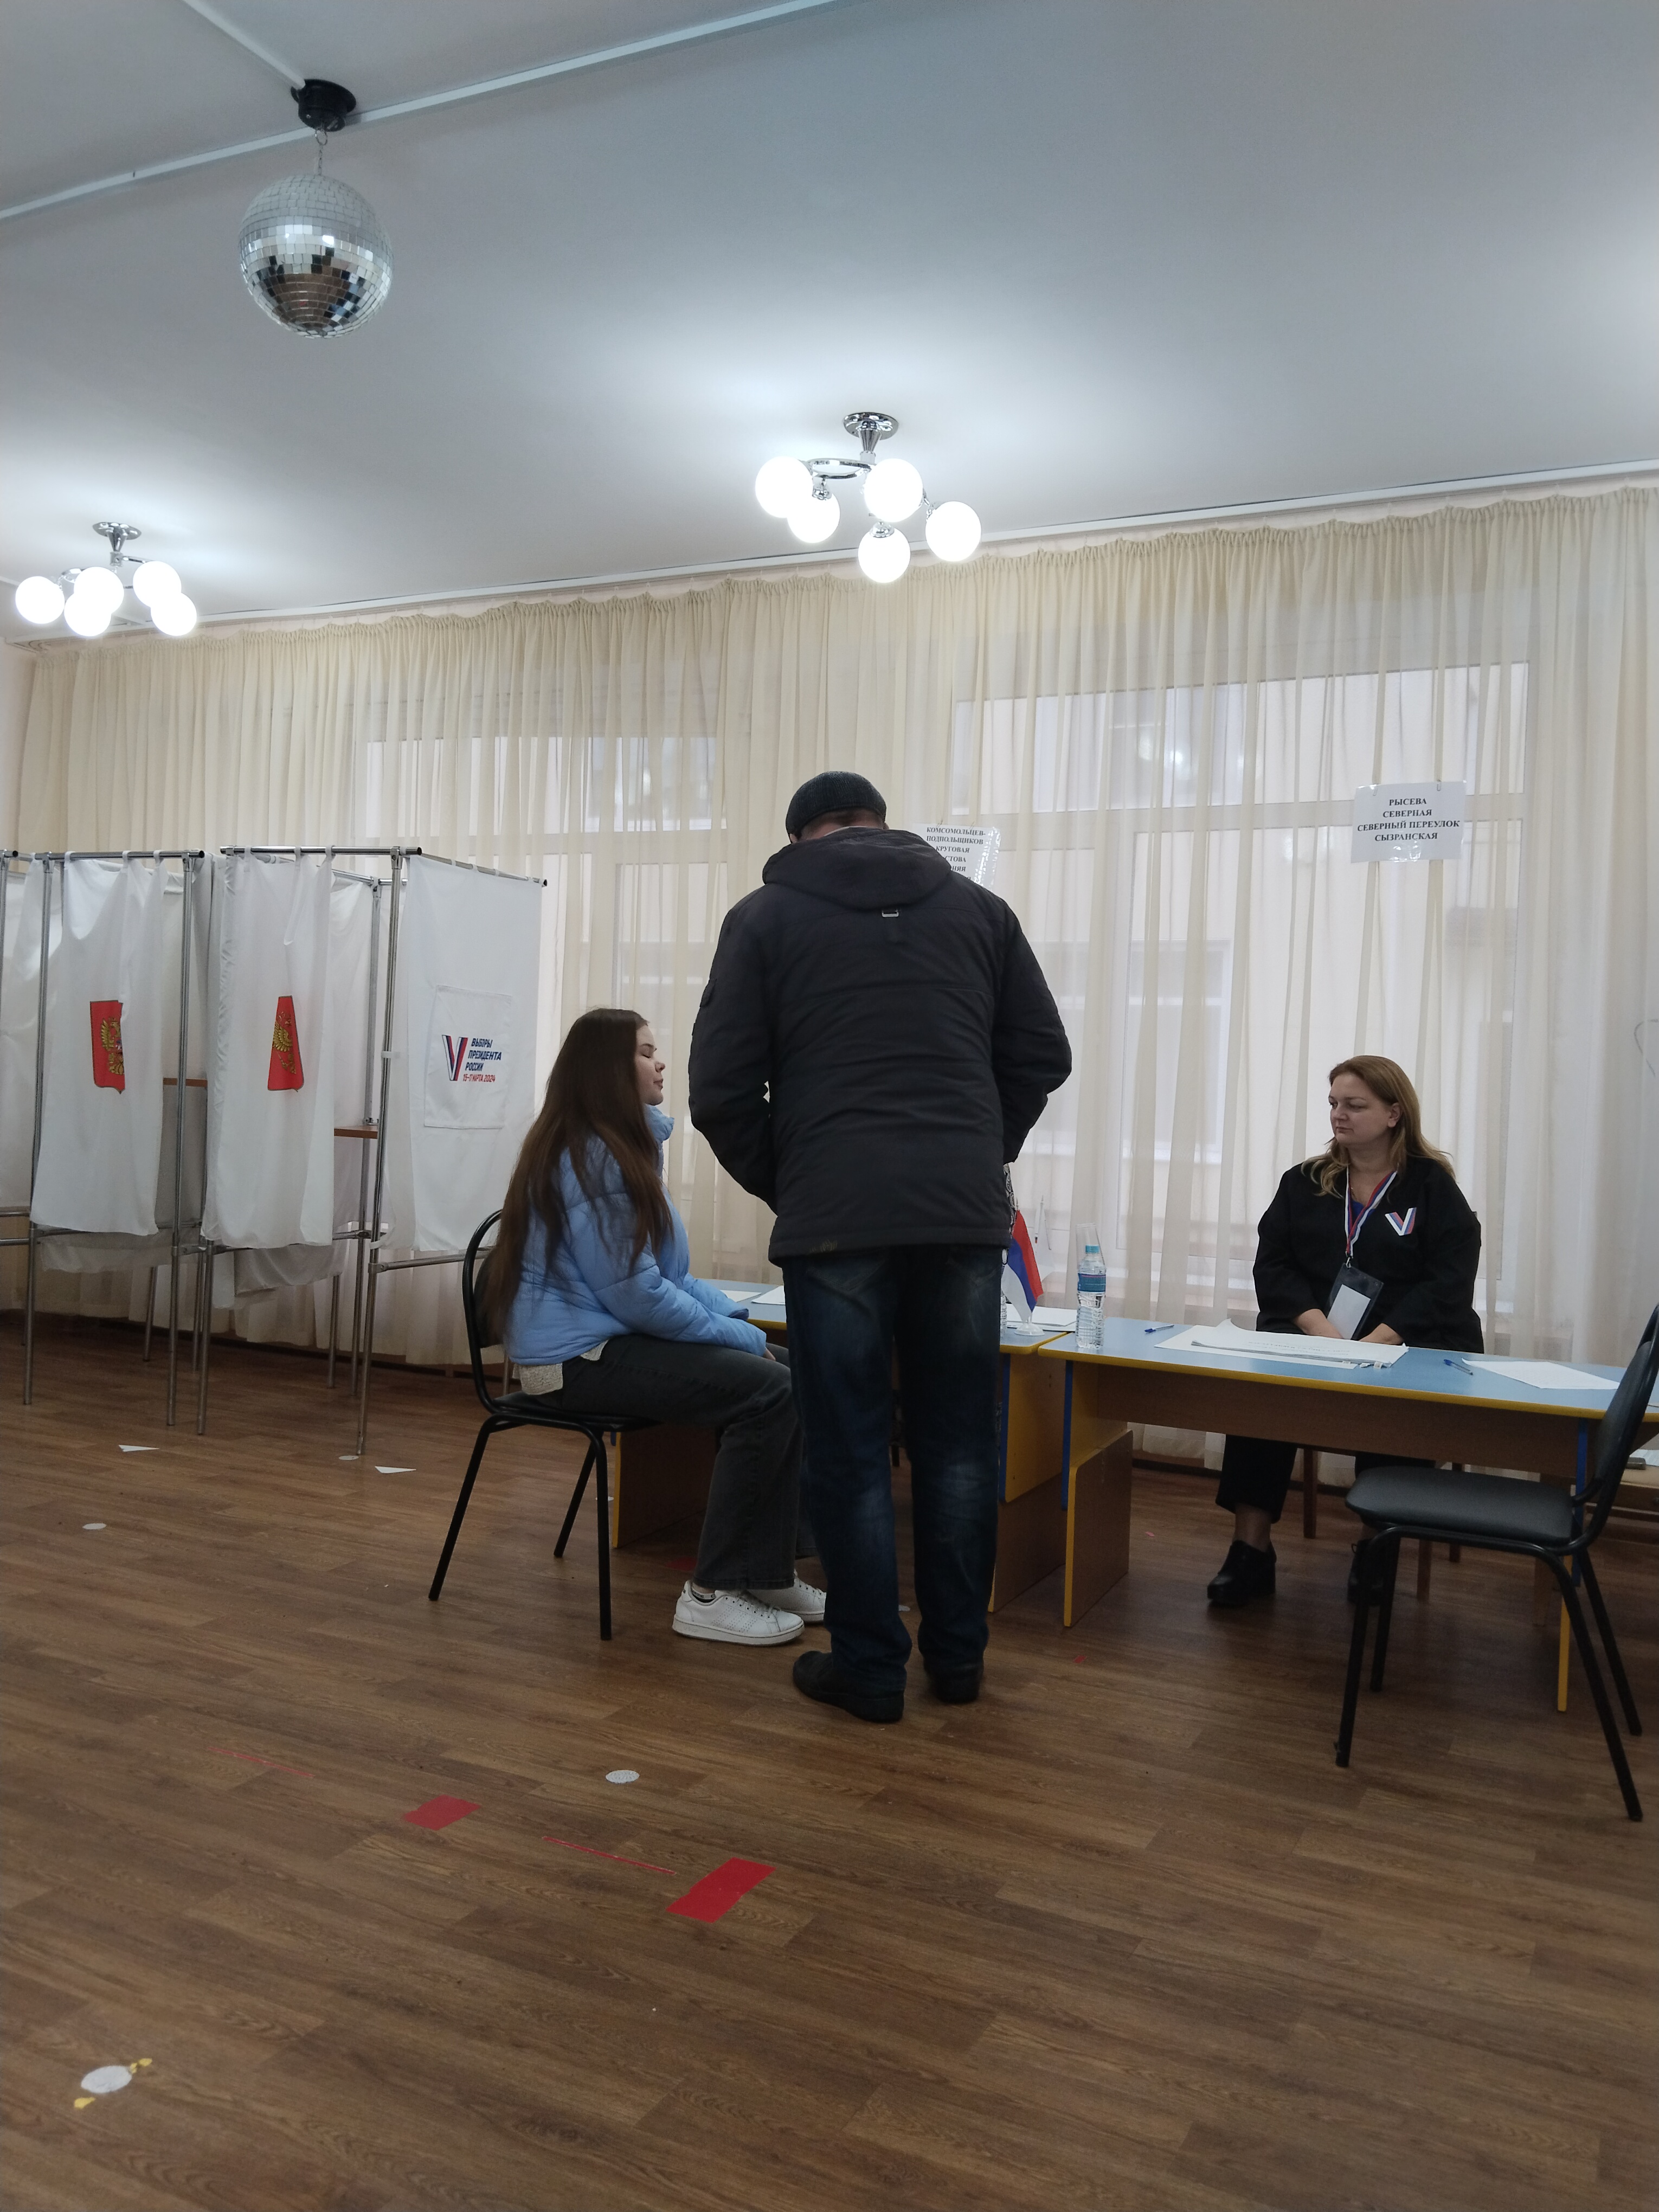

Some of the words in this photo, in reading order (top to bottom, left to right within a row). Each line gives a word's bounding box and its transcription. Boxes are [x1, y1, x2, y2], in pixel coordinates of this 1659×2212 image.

[1389, 798, 1427, 806] РЫСЕВА
[1382, 809, 1432, 818] СЕВЕРНАЯ
[1358, 820, 1406, 831] СЕВЕРНЫЙ
[1409, 820, 1460, 828] ПЕРЕУЛОК
[927, 827, 986, 836] КОМСОМОЛЬЦЕВ-
[927, 835, 983, 845] ПОДПОЛЬЩИКОВ
[1375, 832, 1438, 841] СЫЗРАНСКАЯ
[471, 1038, 493, 1048] ВЫБОРЫ
[468, 1050, 502, 1061] ПРЕЗИДЕНТА
[465, 1062, 484, 1071] РОССИИ
